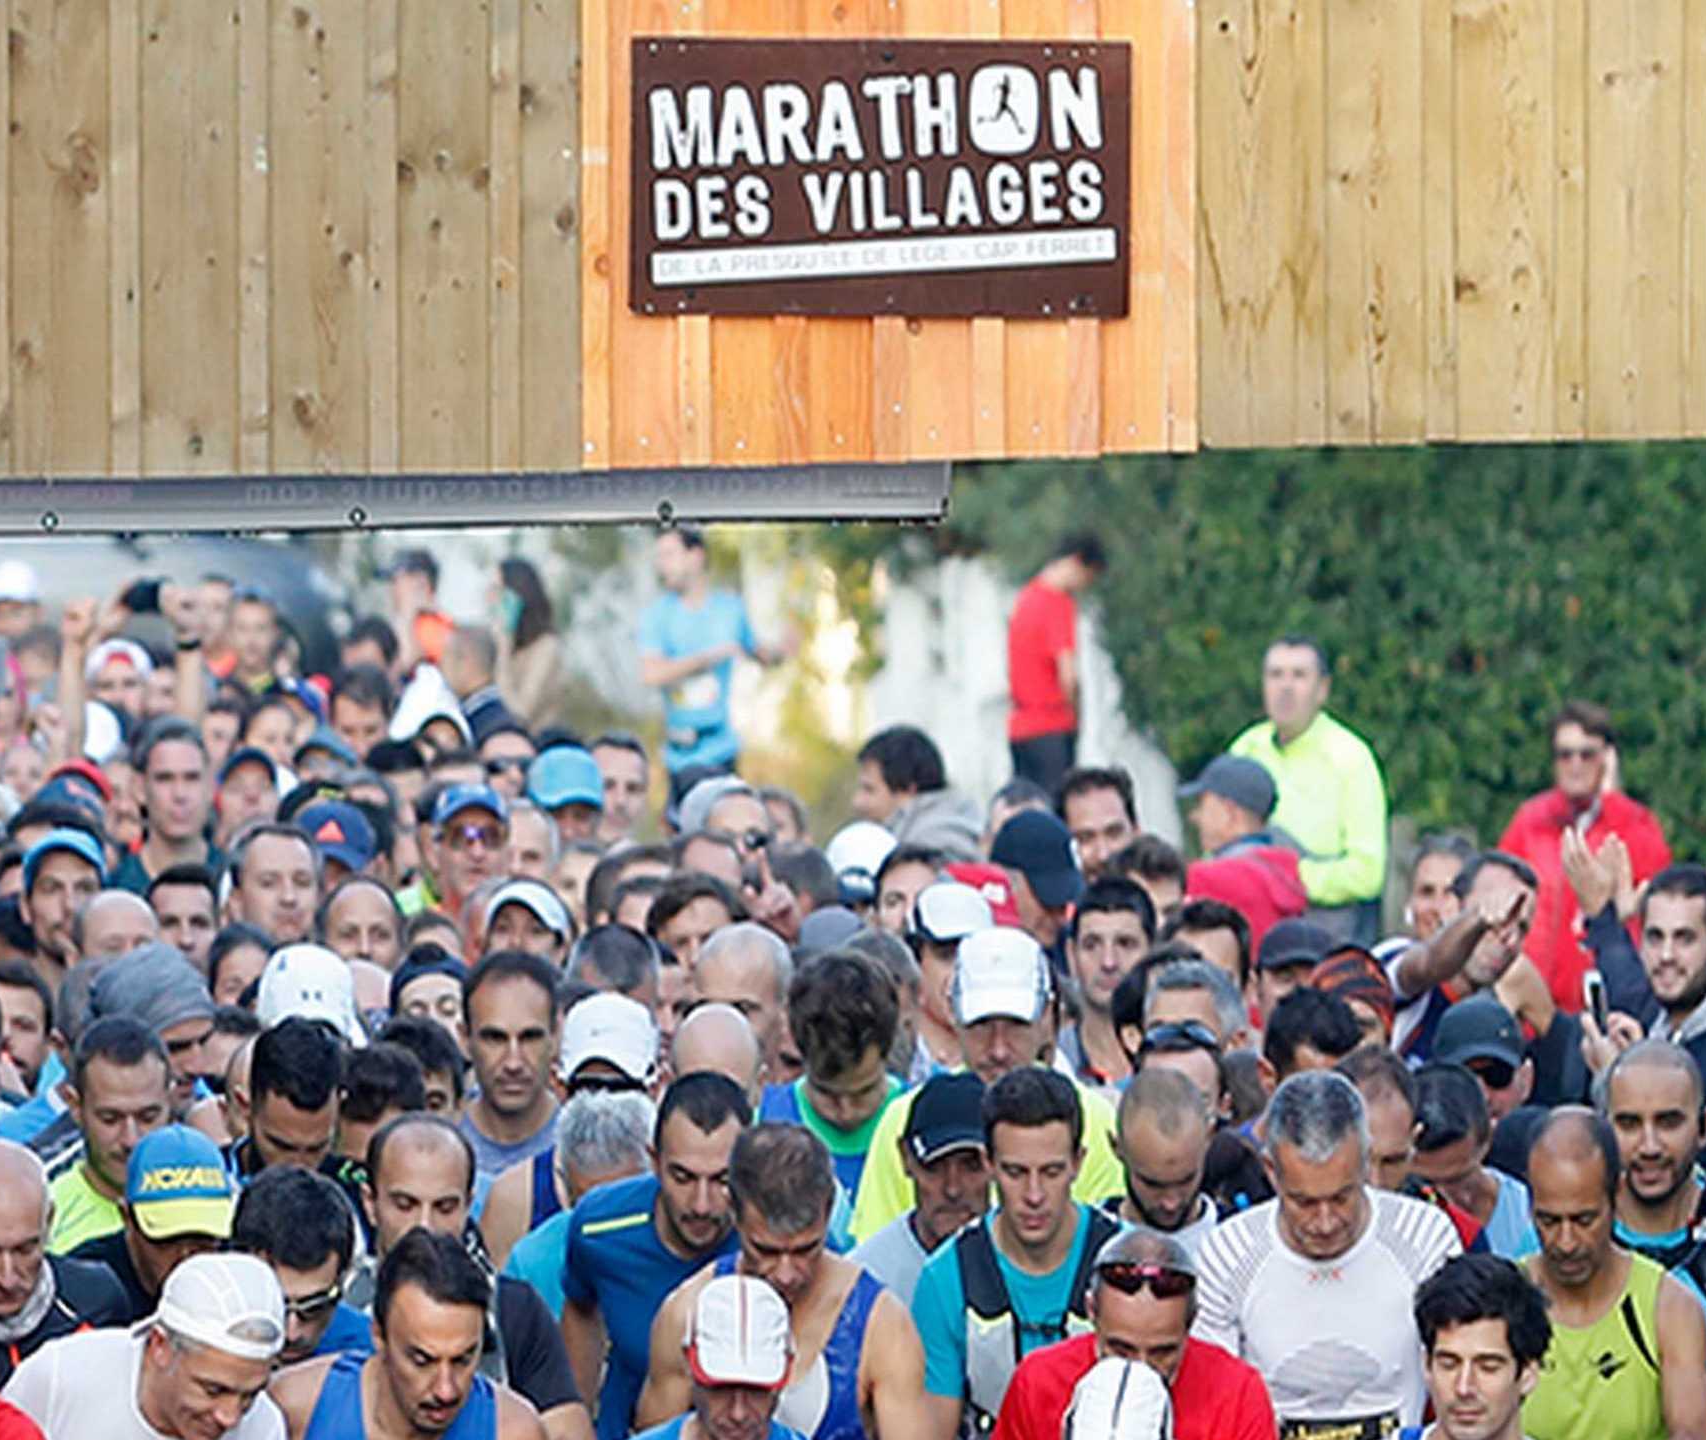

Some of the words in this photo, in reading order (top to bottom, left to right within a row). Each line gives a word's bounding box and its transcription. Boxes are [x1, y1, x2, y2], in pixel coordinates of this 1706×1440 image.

[649, 63, 1104, 171] MARATHON
[654, 175, 771, 241] DES
[802, 159, 1104, 234] VILLAGES
[659, 257, 685, 278] DE
[694, 255, 724, 275] LA
[861, 246, 890, 265] DE
[972, 241, 1019, 260] CAP
[1025, 234, 1105, 254] FERRET
